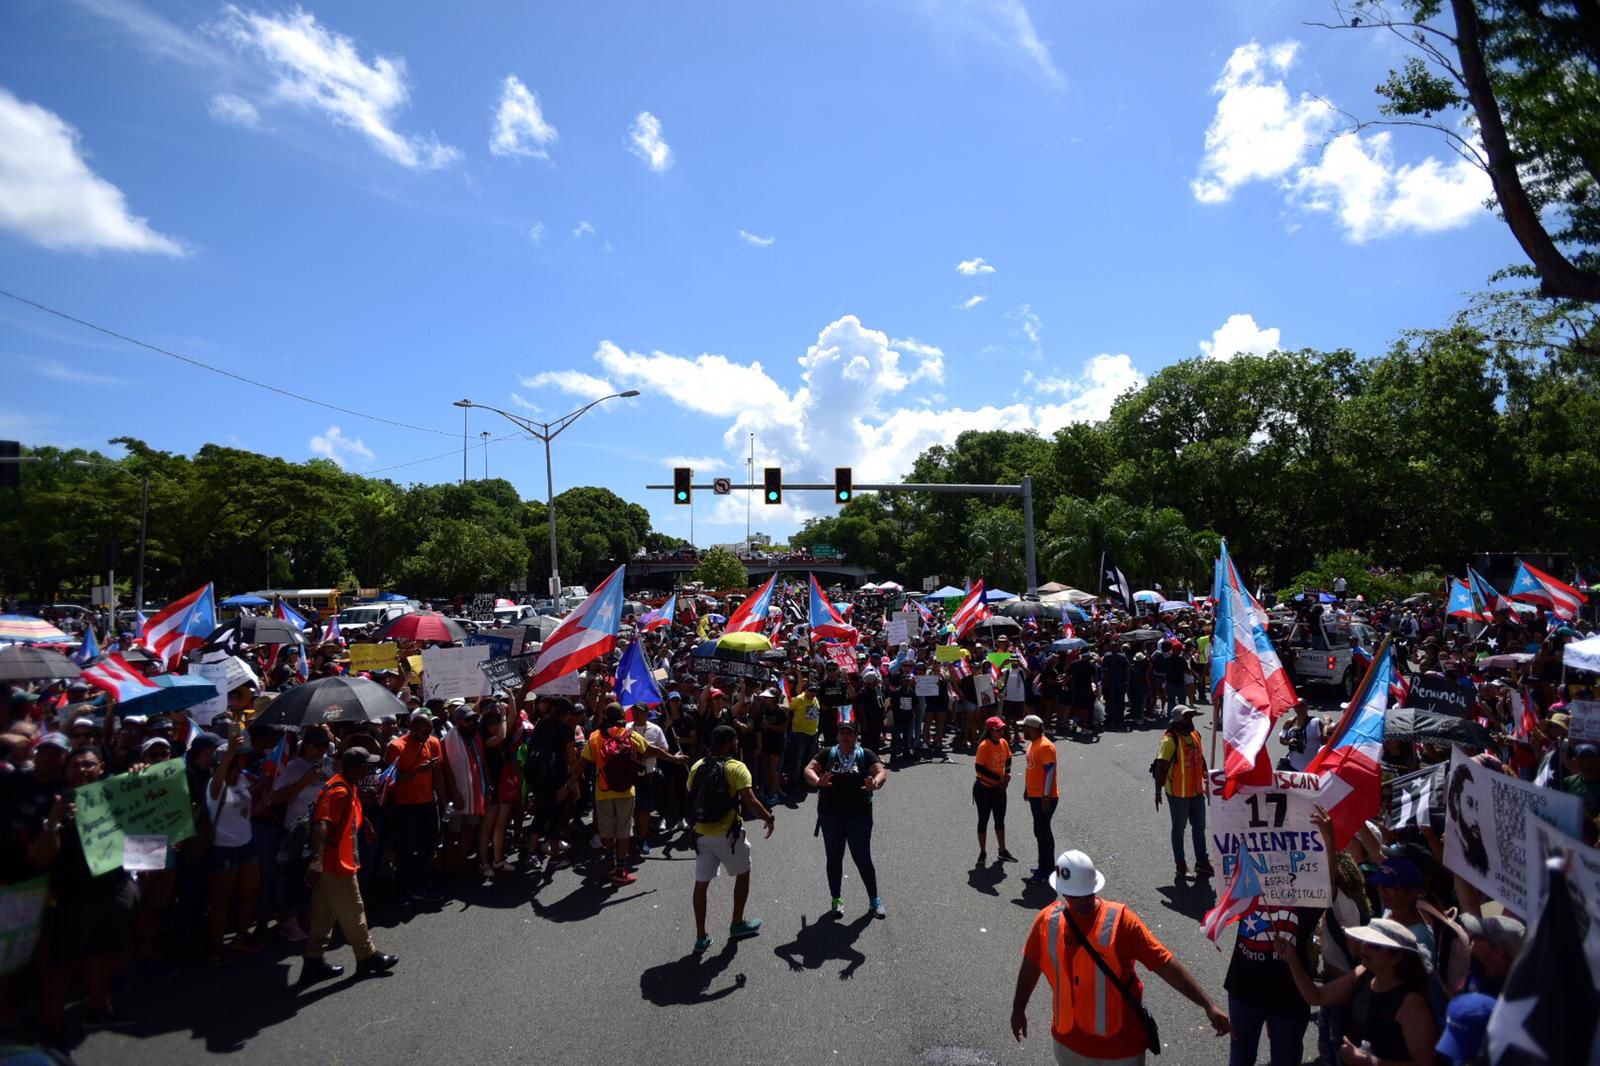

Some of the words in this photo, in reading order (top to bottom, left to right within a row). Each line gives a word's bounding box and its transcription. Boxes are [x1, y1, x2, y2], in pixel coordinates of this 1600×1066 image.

[473, 599, 494, 607] PUTA
[1410, 676, 1466, 707] Renuncia
[1244, 793, 1287, 828] 17
[1213, 831, 1324, 855] VALIENTES
